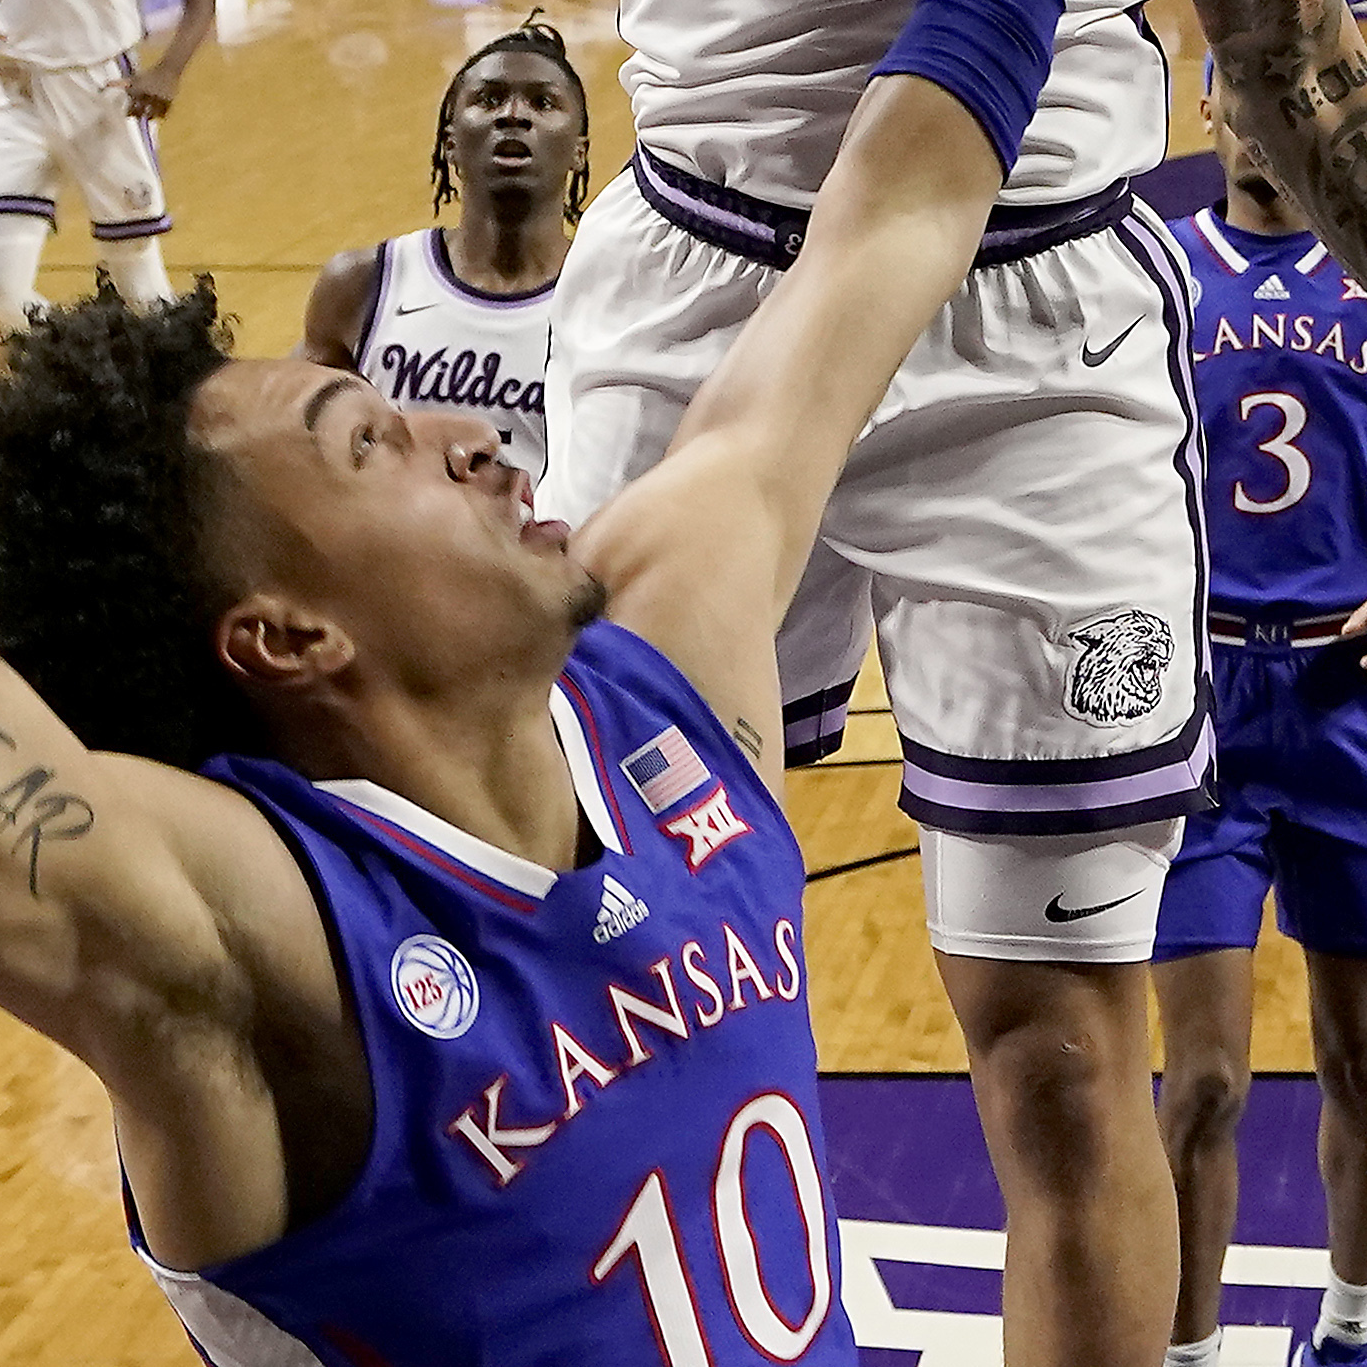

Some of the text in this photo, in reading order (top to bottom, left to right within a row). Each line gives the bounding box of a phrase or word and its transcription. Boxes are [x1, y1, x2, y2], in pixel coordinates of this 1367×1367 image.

[1233, 390, 1313, 514] 3
[404, 972, 444, 1012] 125
[447, 914, 803, 1190] KANSAS
[587, 1089, 837, 1367] 10
